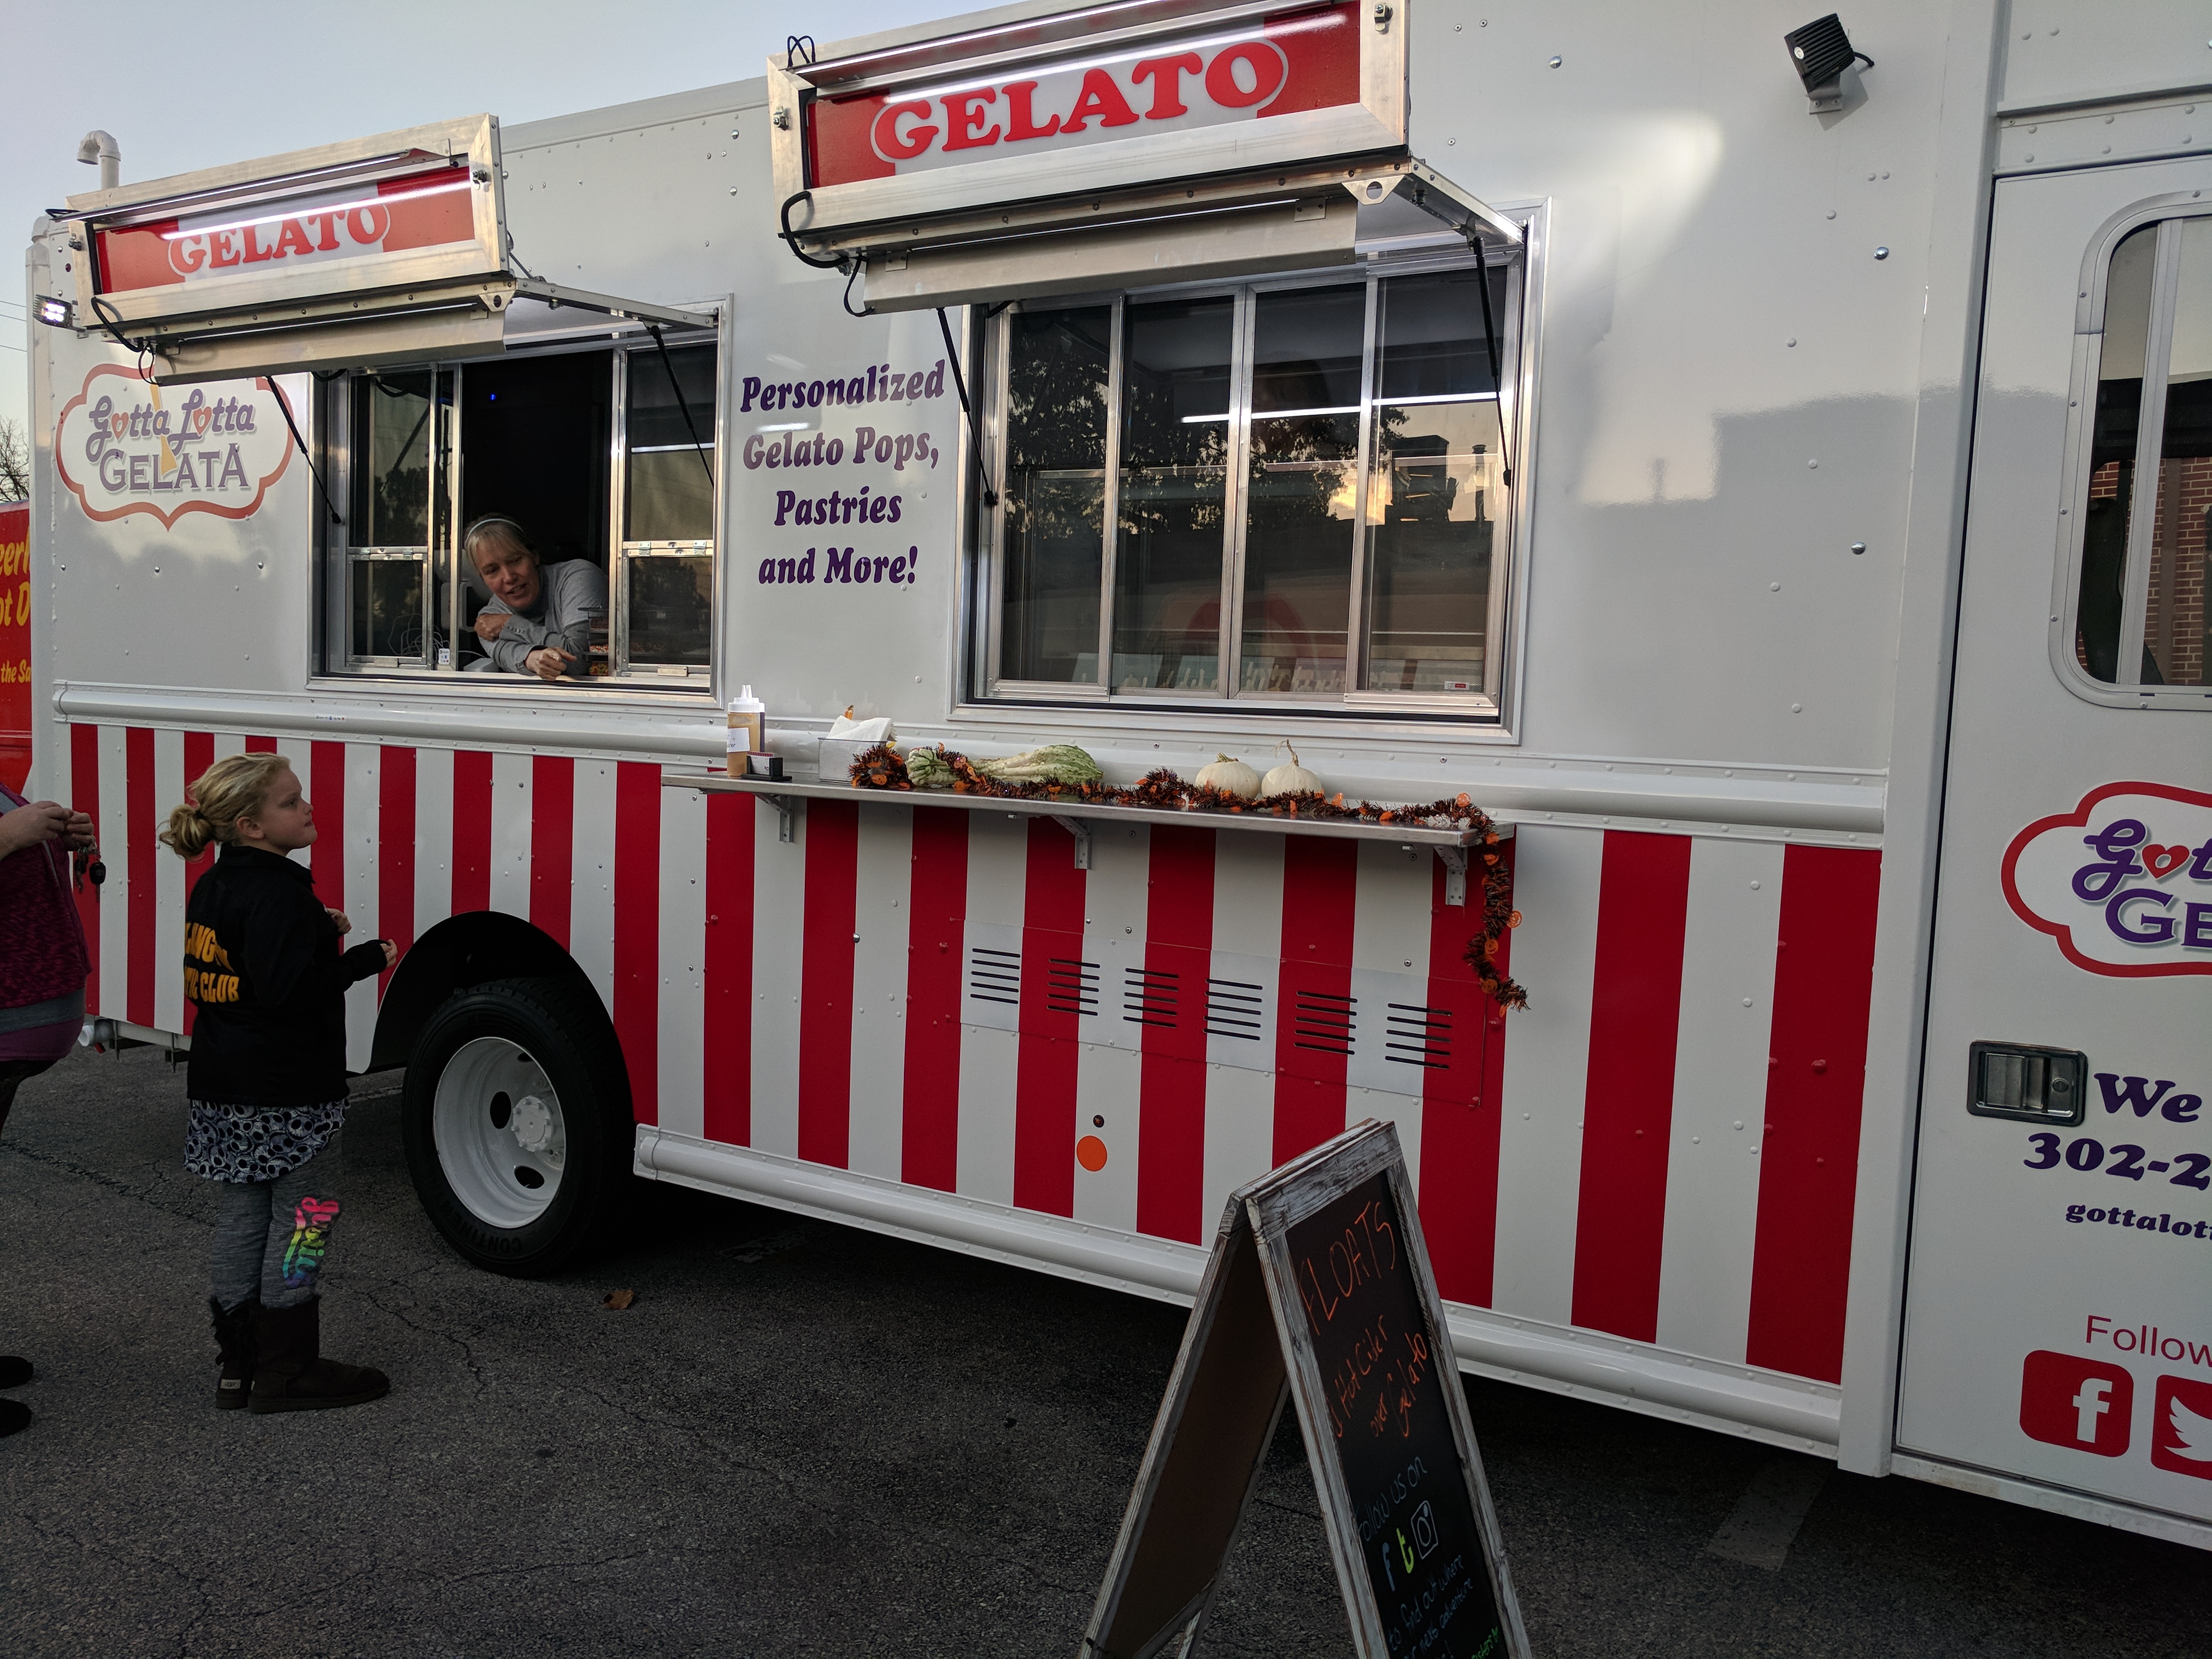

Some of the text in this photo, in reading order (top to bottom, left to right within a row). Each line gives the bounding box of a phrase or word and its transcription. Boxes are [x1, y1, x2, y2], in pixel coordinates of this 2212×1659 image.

[874, 42, 1284, 160] GELATO
[171, 200, 386, 273] GELATO
[740, 359, 945, 413] Personalized
[86, 389, 255, 462] Gotta Lotta
[743, 426, 939, 471] Gelato Pops,
[99, 443, 249, 492] GELATA
[774, 486, 902, 526] Pastries
[758, 545, 918, 584] and More!
[1, 660, 17, 683] the
[200, 972, 240, 1003] CLUB
[2094, 1073, 2202, 1122] We
[2023, 1133, 2212, 1191] 302-2
[2066, 1204, 2212, 1240] gottalot
[1298, 1201, 1397, 1336] FLOATS
[2086, 1315, 2212, 1367] Follow
[1334, 1358, 1361, 1419] Hot
[1390, 1473, 1407, 1504] us
[1408, 1456, 1427, 1487] on
